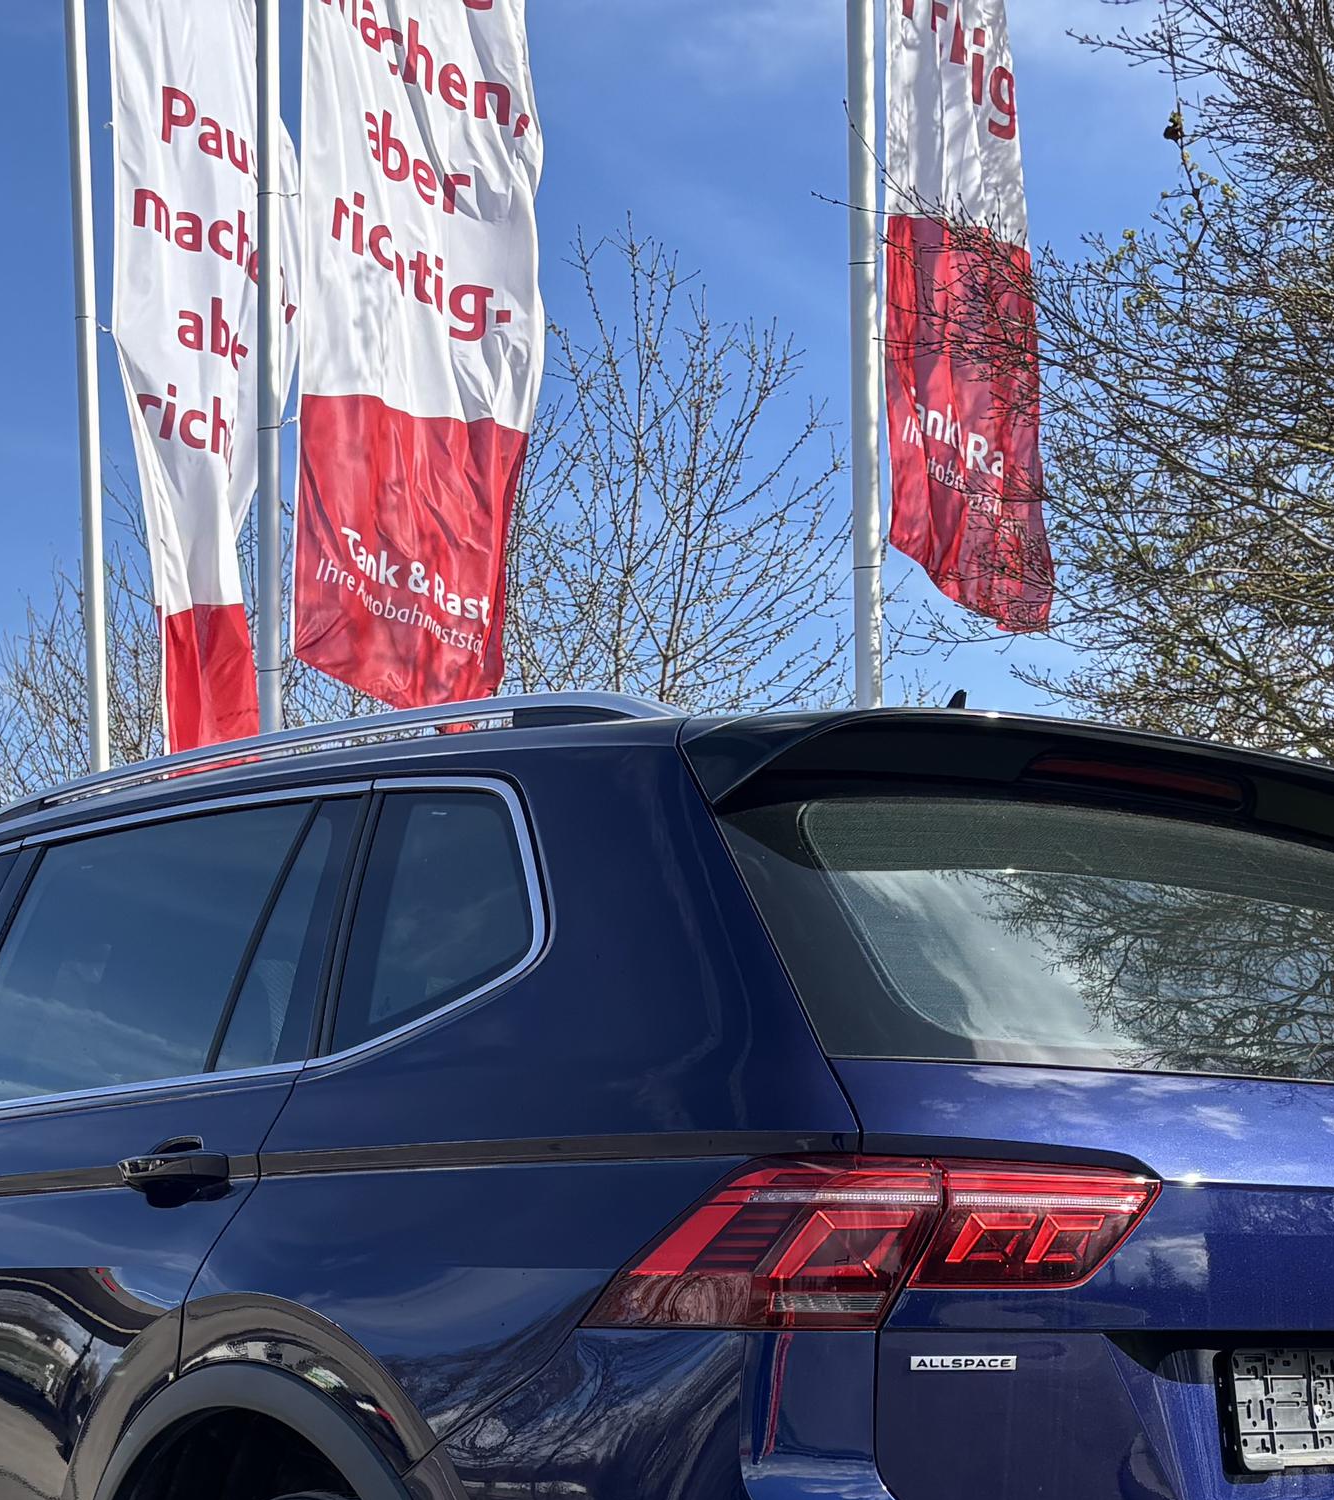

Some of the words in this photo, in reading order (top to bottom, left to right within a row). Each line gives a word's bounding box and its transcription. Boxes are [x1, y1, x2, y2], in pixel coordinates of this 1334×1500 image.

[161, 86, 259, 184] Pau
[364, 109, 471, 215] aber
[315, 558, 355, 591] Ihre
[341, 526, 400, 588] Tank
[408, 560, 430, 597] &
[434, 571, 490, 627] Rast
[916, 1358, 1012, 1368] ALLSPACE
